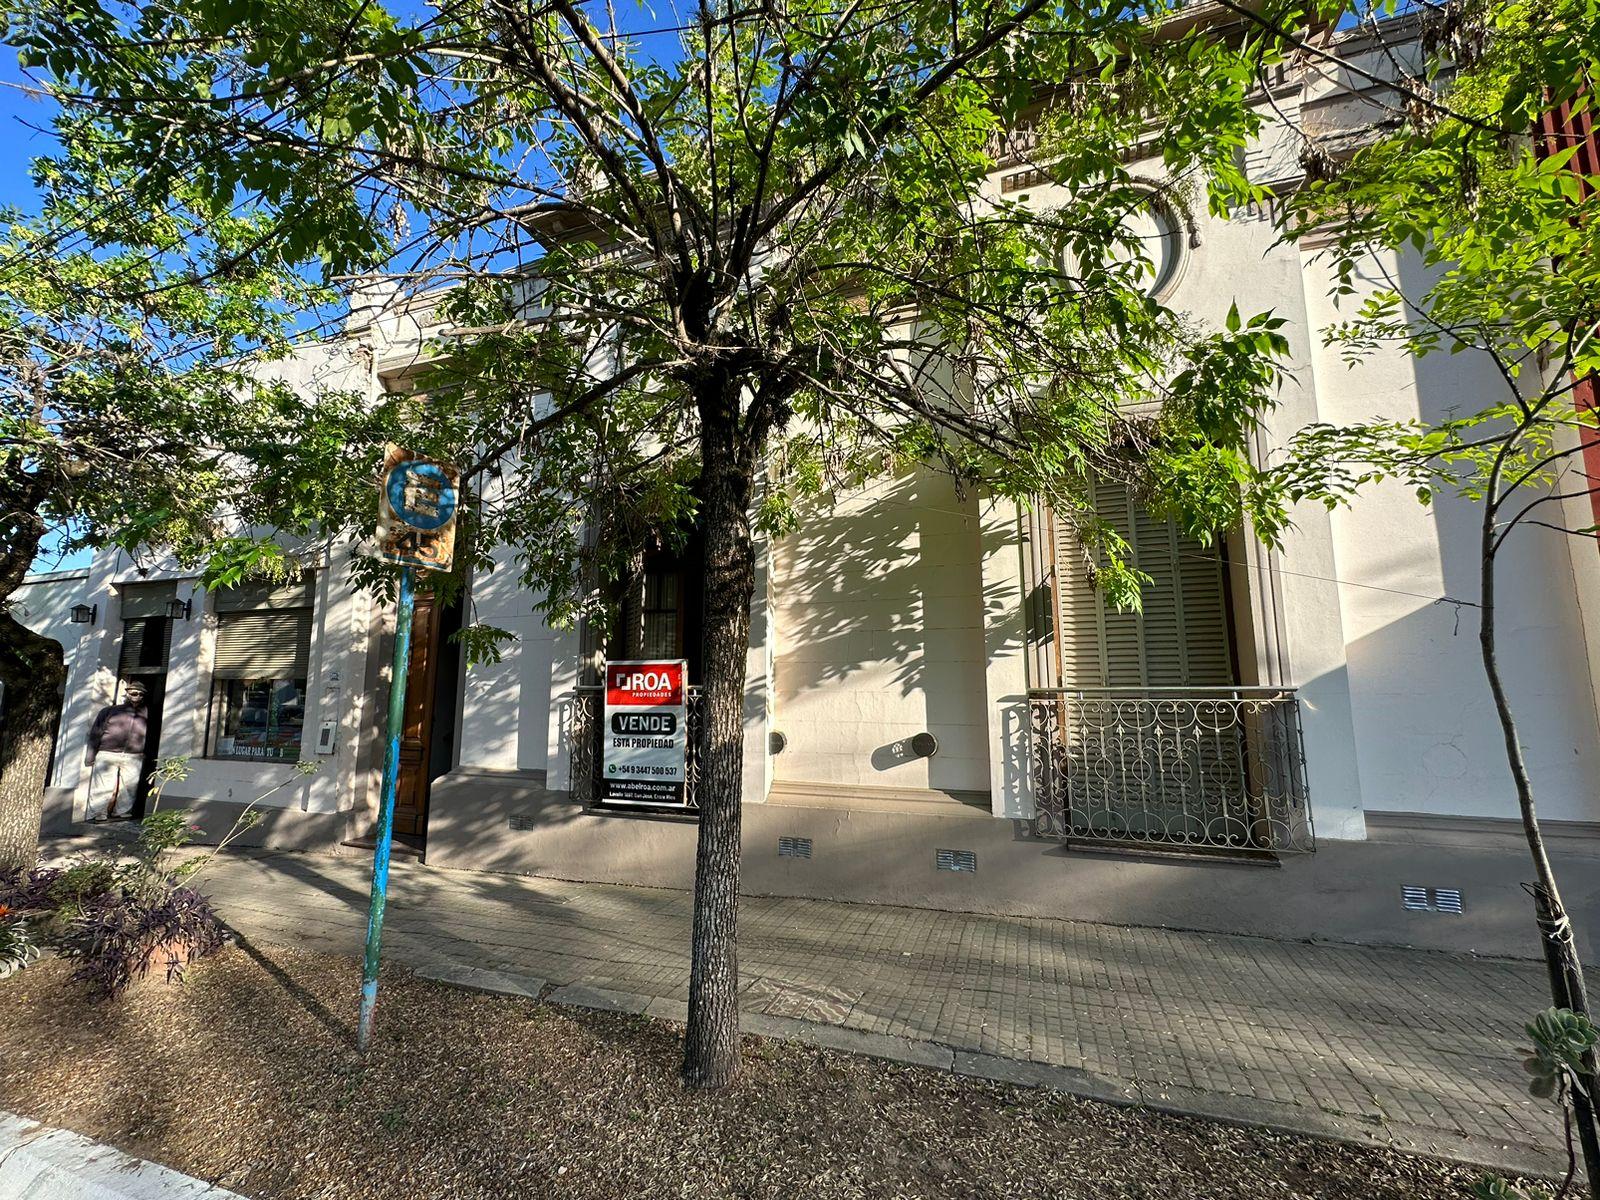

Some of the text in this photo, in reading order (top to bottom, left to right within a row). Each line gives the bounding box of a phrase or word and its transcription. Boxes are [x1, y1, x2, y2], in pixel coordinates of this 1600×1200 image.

[404, 469, 441, 518] E
[632, 672, 672, 691] ROA
[618, 715, 671, 731] VENDE
[613, 737, 674, 749] ESTA PROPIEDAD
[236, 746, 251, 755] LUGAR
[251, 746, 264, 756] PARA
[618, 765, 677, 776] +54 9 3447 500 537
[609, 782, 676, 792] www.abelroa.com.ar
